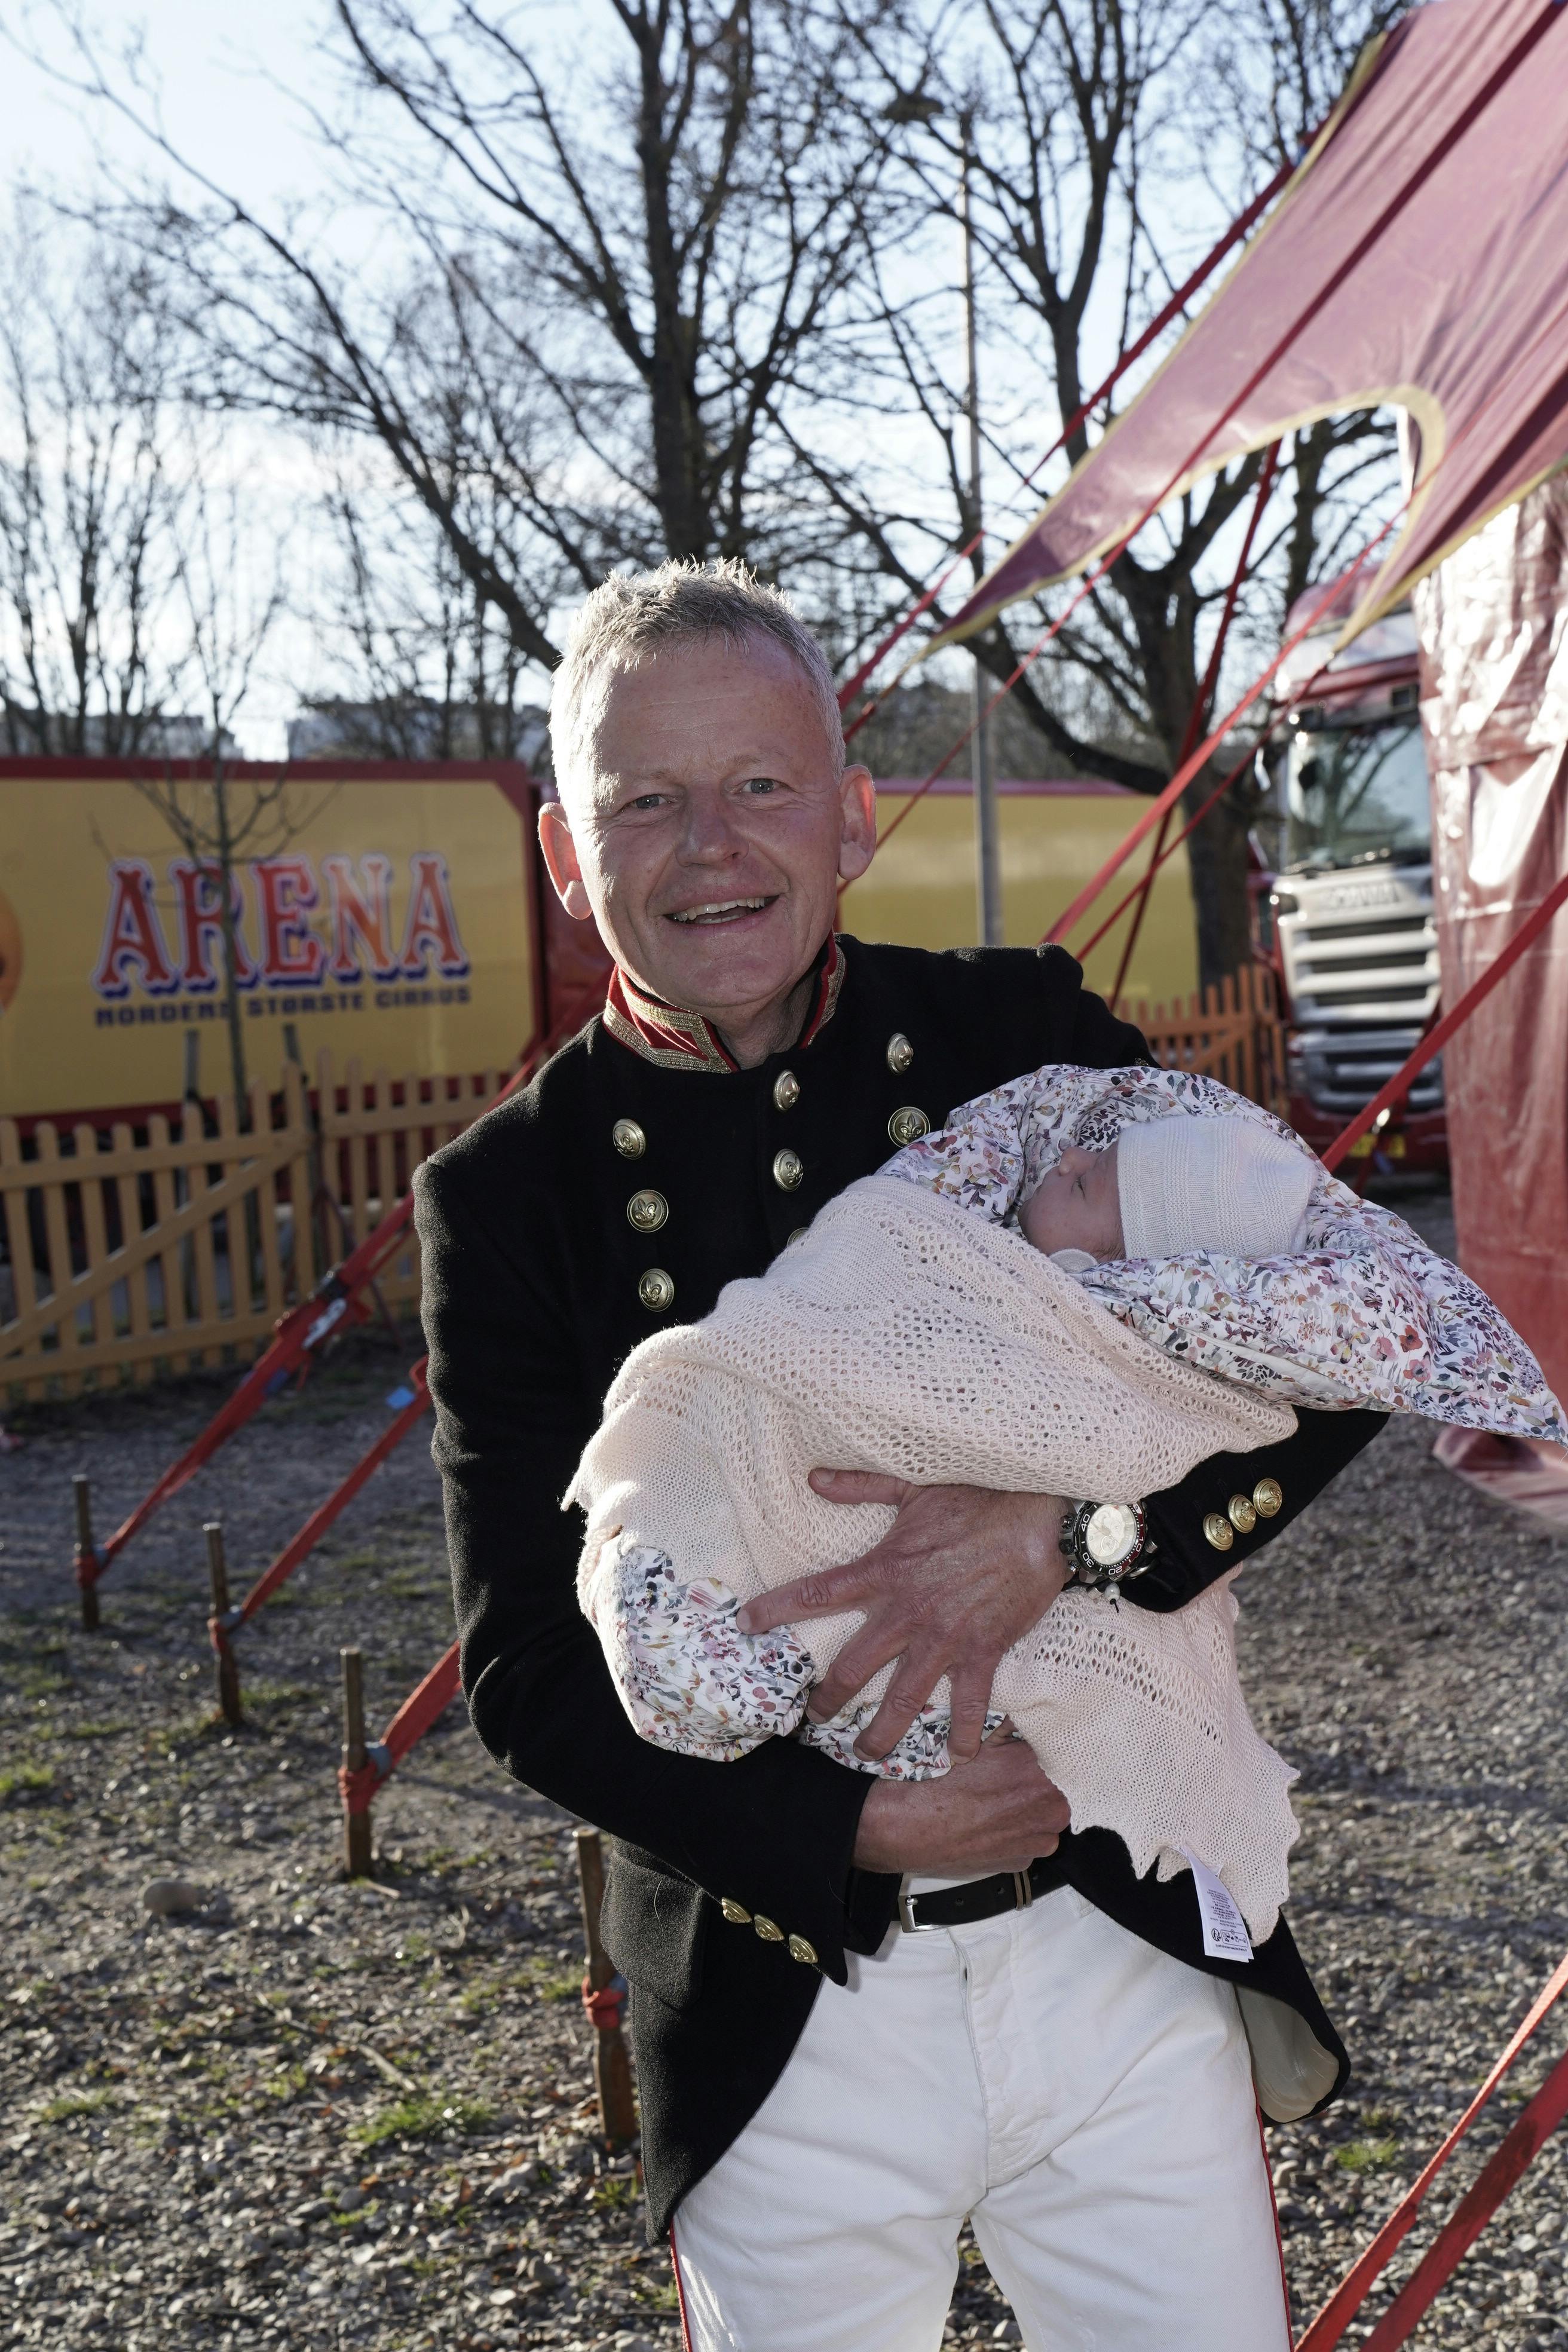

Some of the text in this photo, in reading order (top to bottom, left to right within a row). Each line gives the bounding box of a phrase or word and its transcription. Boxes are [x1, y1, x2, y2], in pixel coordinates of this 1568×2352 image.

[92, 852, 470, 999] ARENA
[1081, 1514, 1090, 1532] 40
[1136, 1536, 1144, 1552] 10
[1082, 1552, 1094, 1567] 30
[1108, 1566, 1122, 1575] 20
